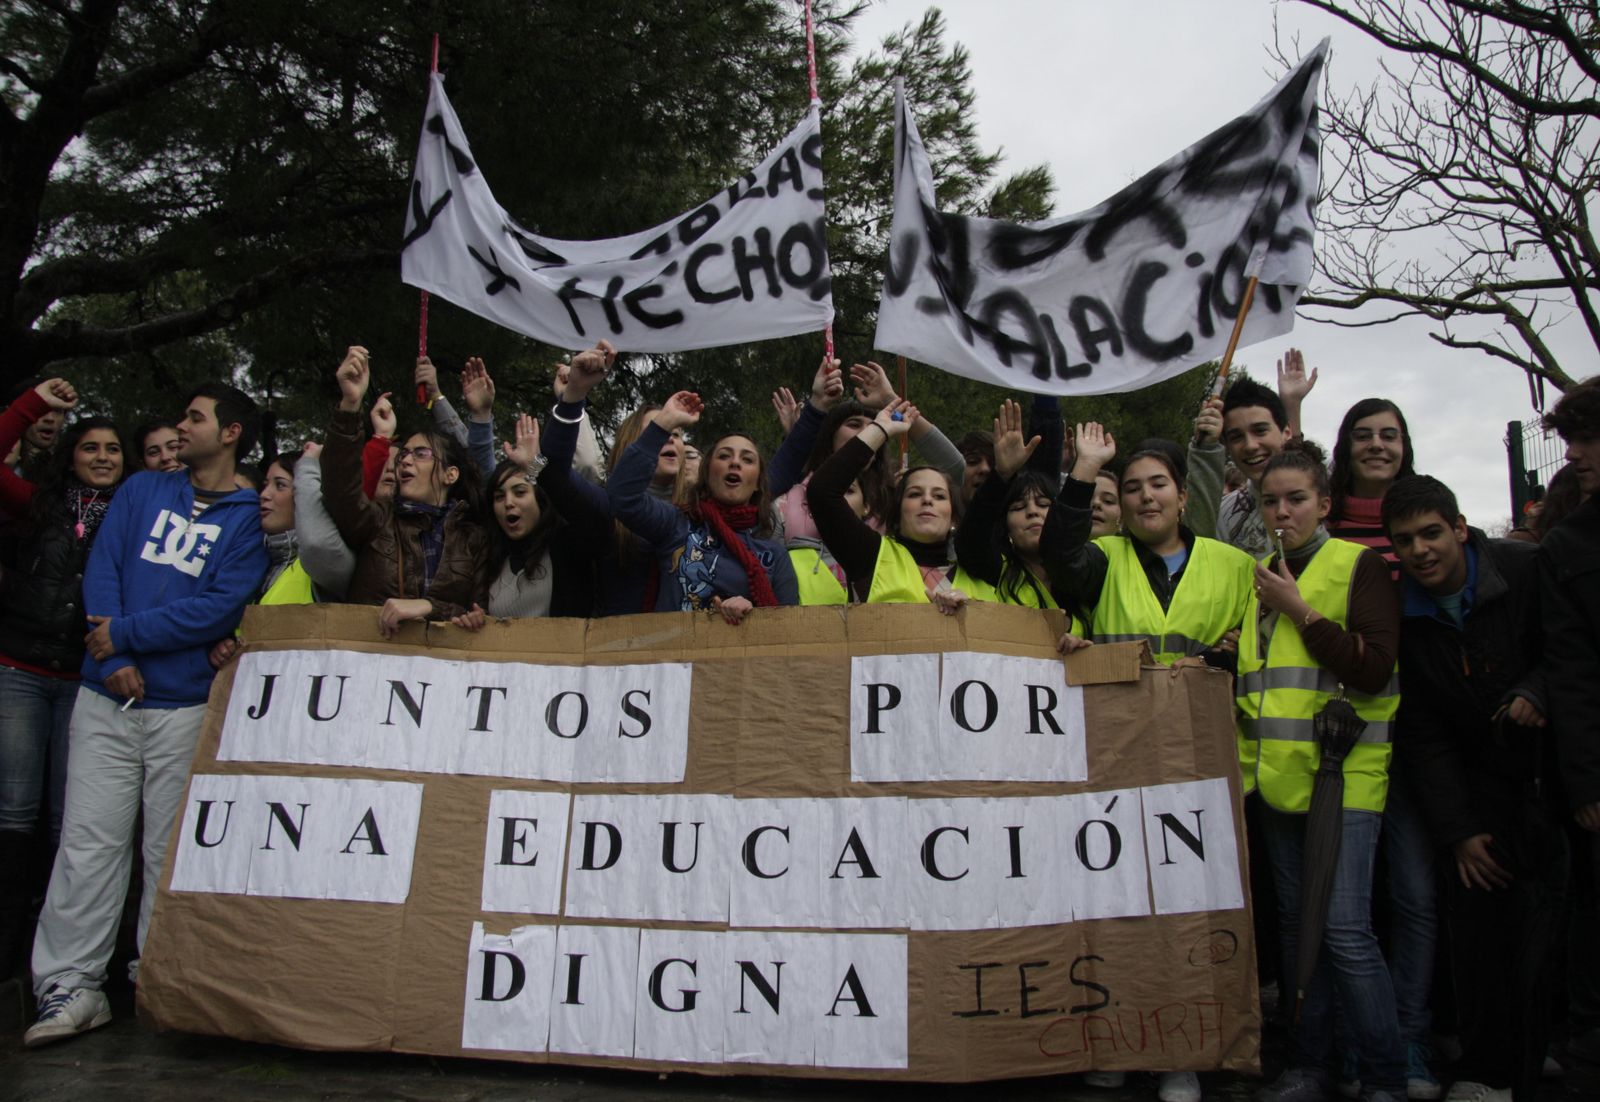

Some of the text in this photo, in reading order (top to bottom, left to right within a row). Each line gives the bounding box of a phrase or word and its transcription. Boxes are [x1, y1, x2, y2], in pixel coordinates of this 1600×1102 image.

[247, 674, 1065, 740] JUNTOS POR
[194, 795, 1206, 882] UNA EDUCACIÓN
[476, 949, 878, 1018] DIGNA
[952, 955, 1120, 1018] I.E.S.
